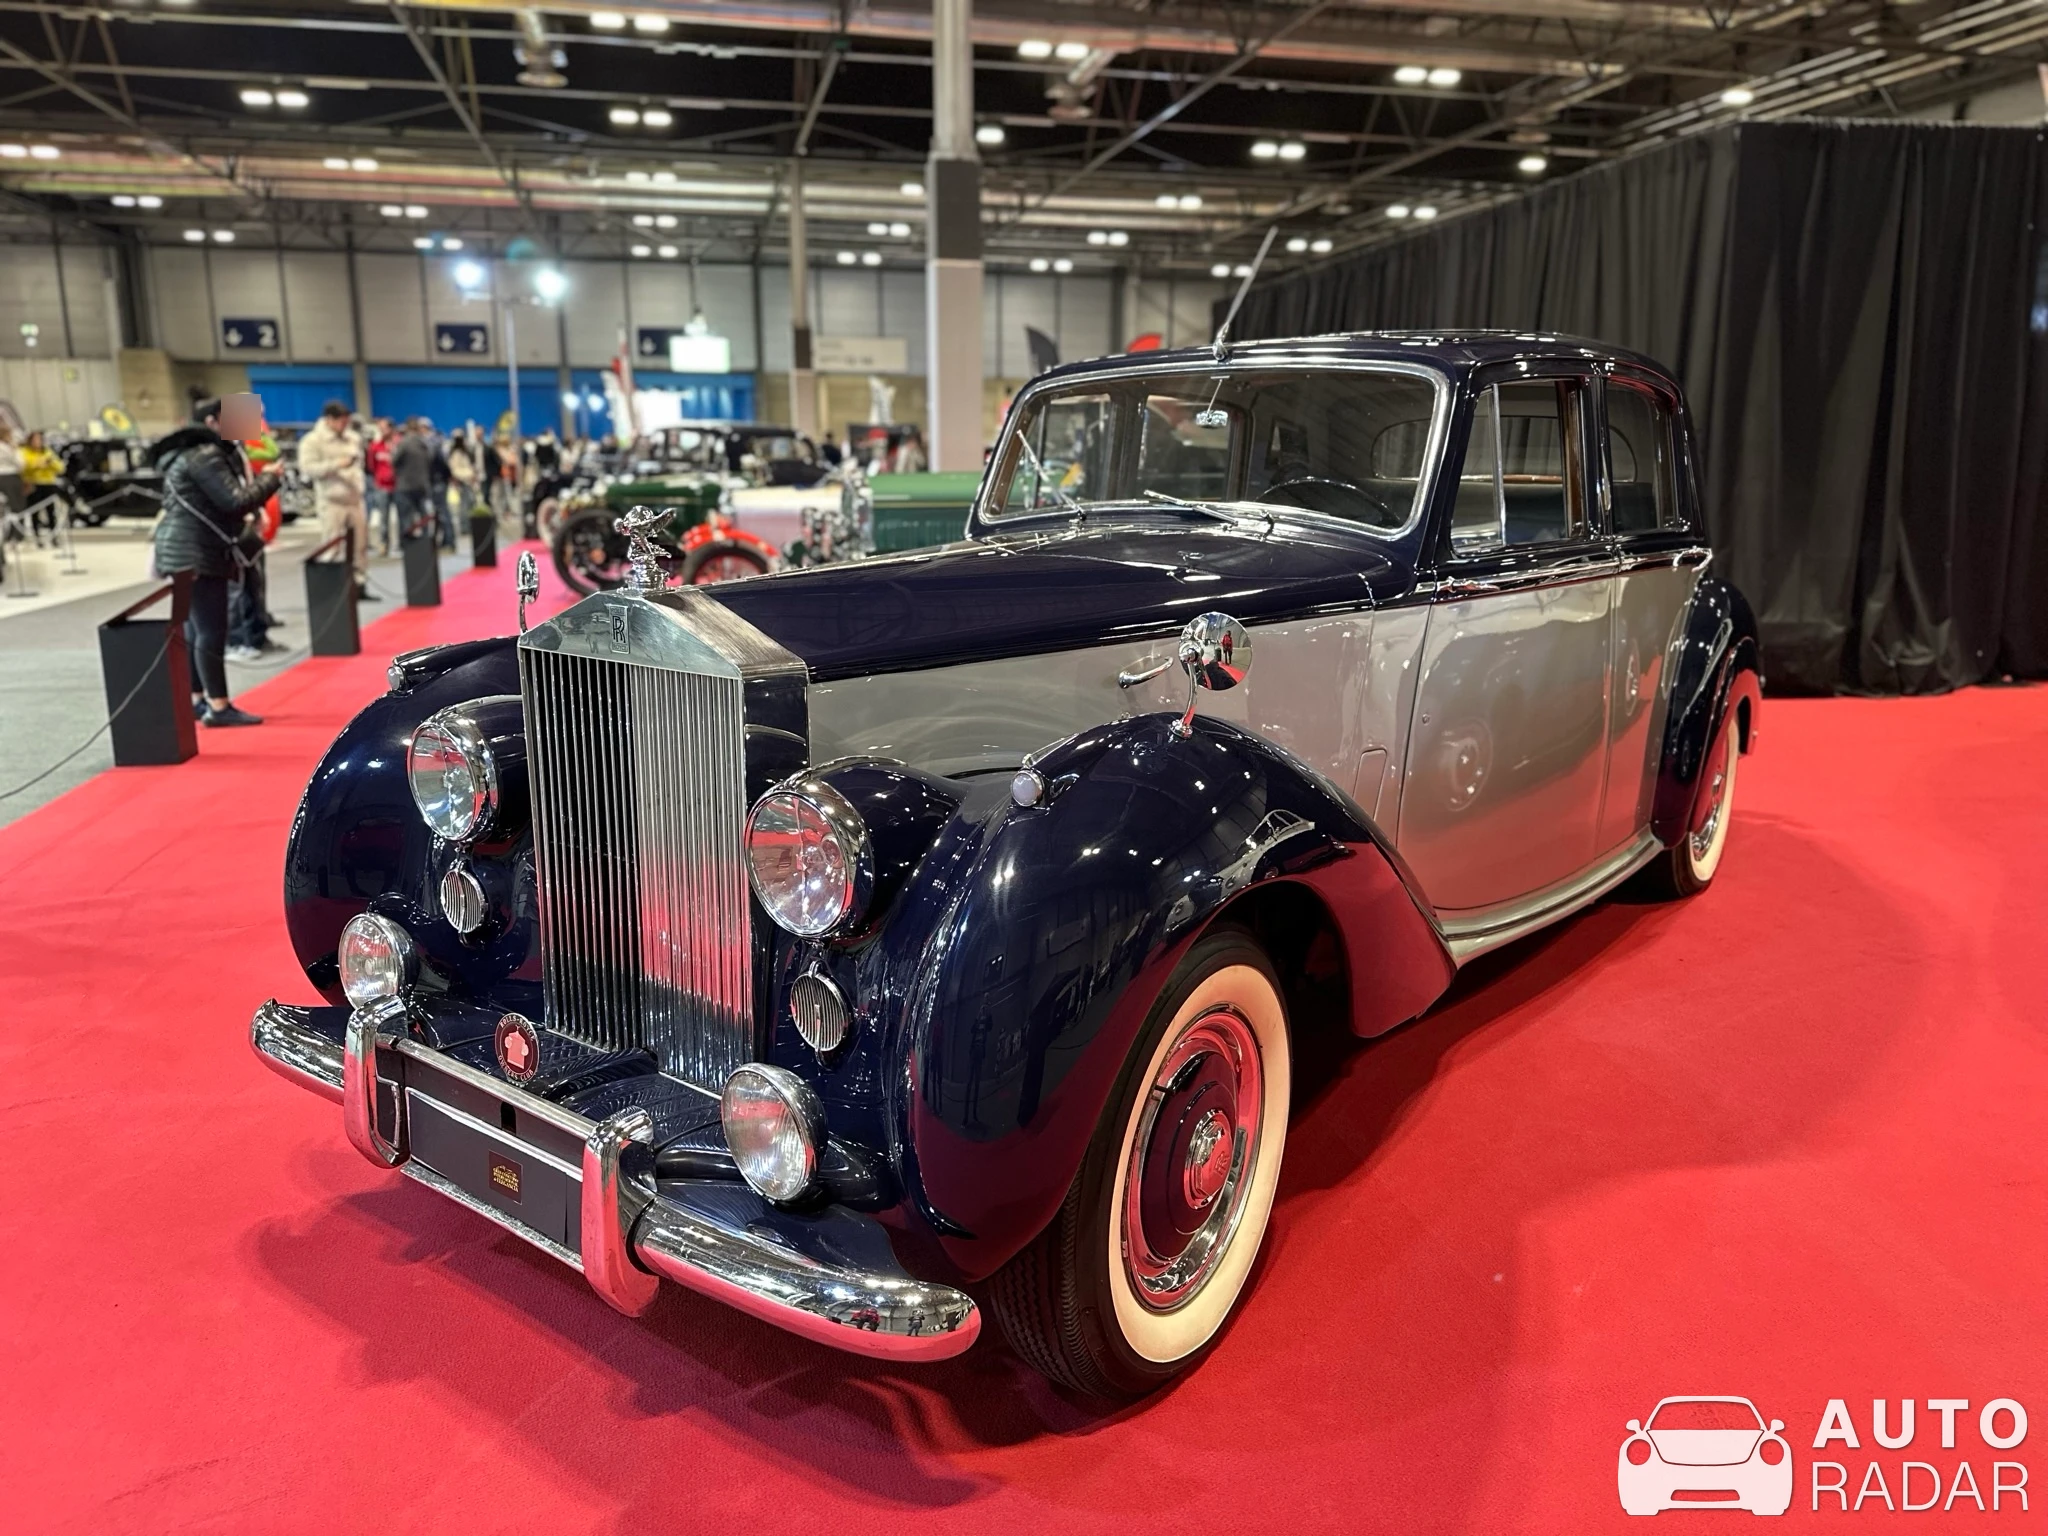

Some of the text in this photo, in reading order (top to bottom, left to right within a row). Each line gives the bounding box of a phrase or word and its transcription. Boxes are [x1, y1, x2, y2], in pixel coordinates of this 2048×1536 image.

[258, 324, 276, 347] 2
[469, 330, 487, 352] 2
[520, 1069, 534, 1081] CLUB
